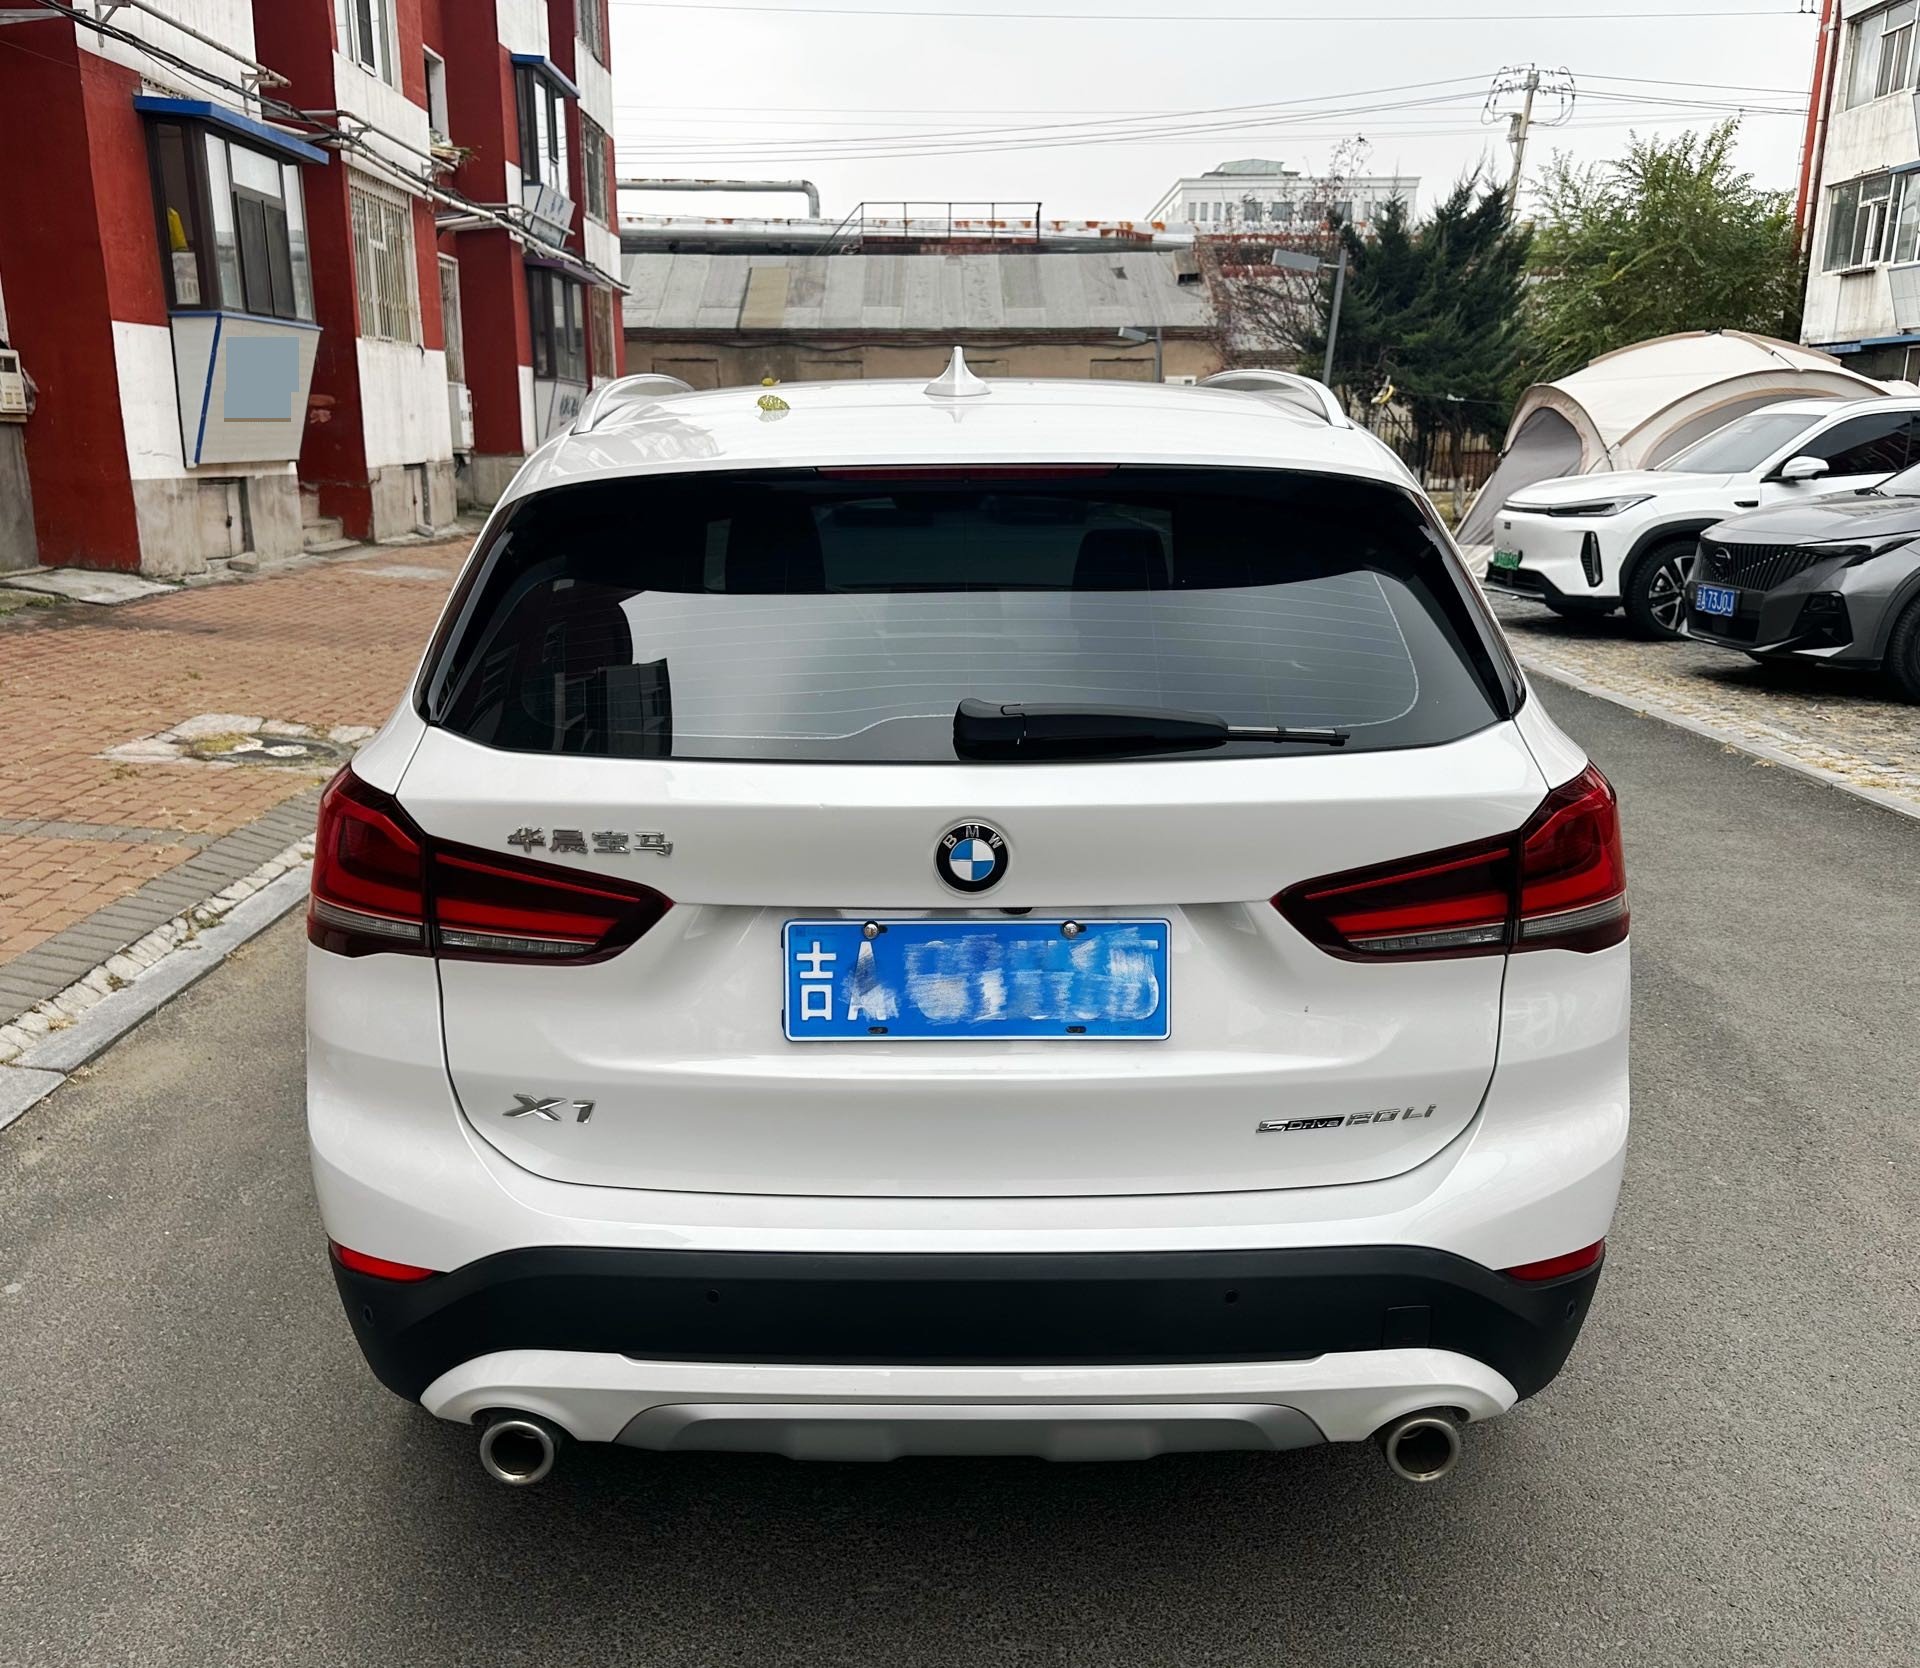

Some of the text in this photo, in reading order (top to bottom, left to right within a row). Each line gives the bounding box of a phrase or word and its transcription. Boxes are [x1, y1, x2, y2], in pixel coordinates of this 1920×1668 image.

[507, 826, 673, 856] 华晨宝马
[942, 825, 1004, 850] BMW
[502, 1093, 596, 1124] X1
